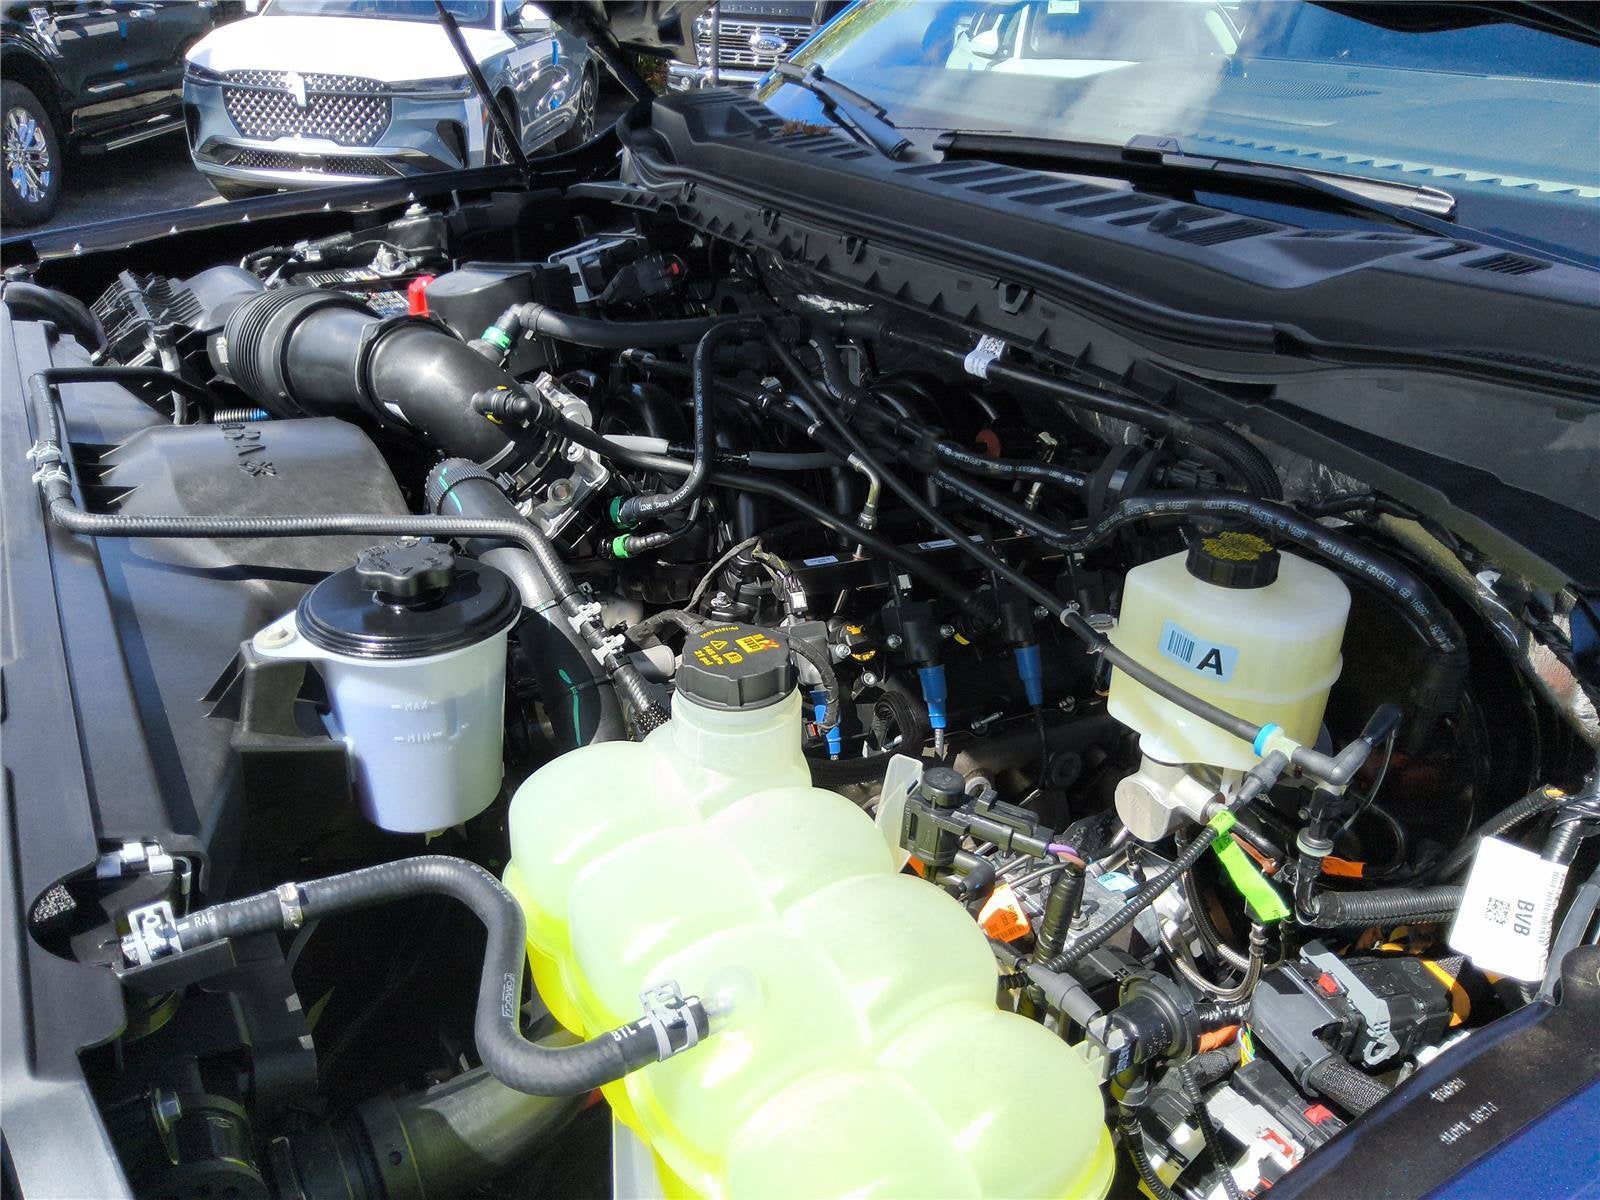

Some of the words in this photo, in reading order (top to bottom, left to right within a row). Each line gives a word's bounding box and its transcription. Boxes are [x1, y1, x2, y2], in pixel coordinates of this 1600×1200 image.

[1342, 551, 1366, 570] BRAKE
[1197, 647, 1224, 677] A
[404, 700, 427, 711] MAX
[407, 732, 430, 742] MIN
[194, 913, 213, 927] RAD
[1514, 900, 1535, 936] BVB
[611, 1025, 637, 1041] BTL
